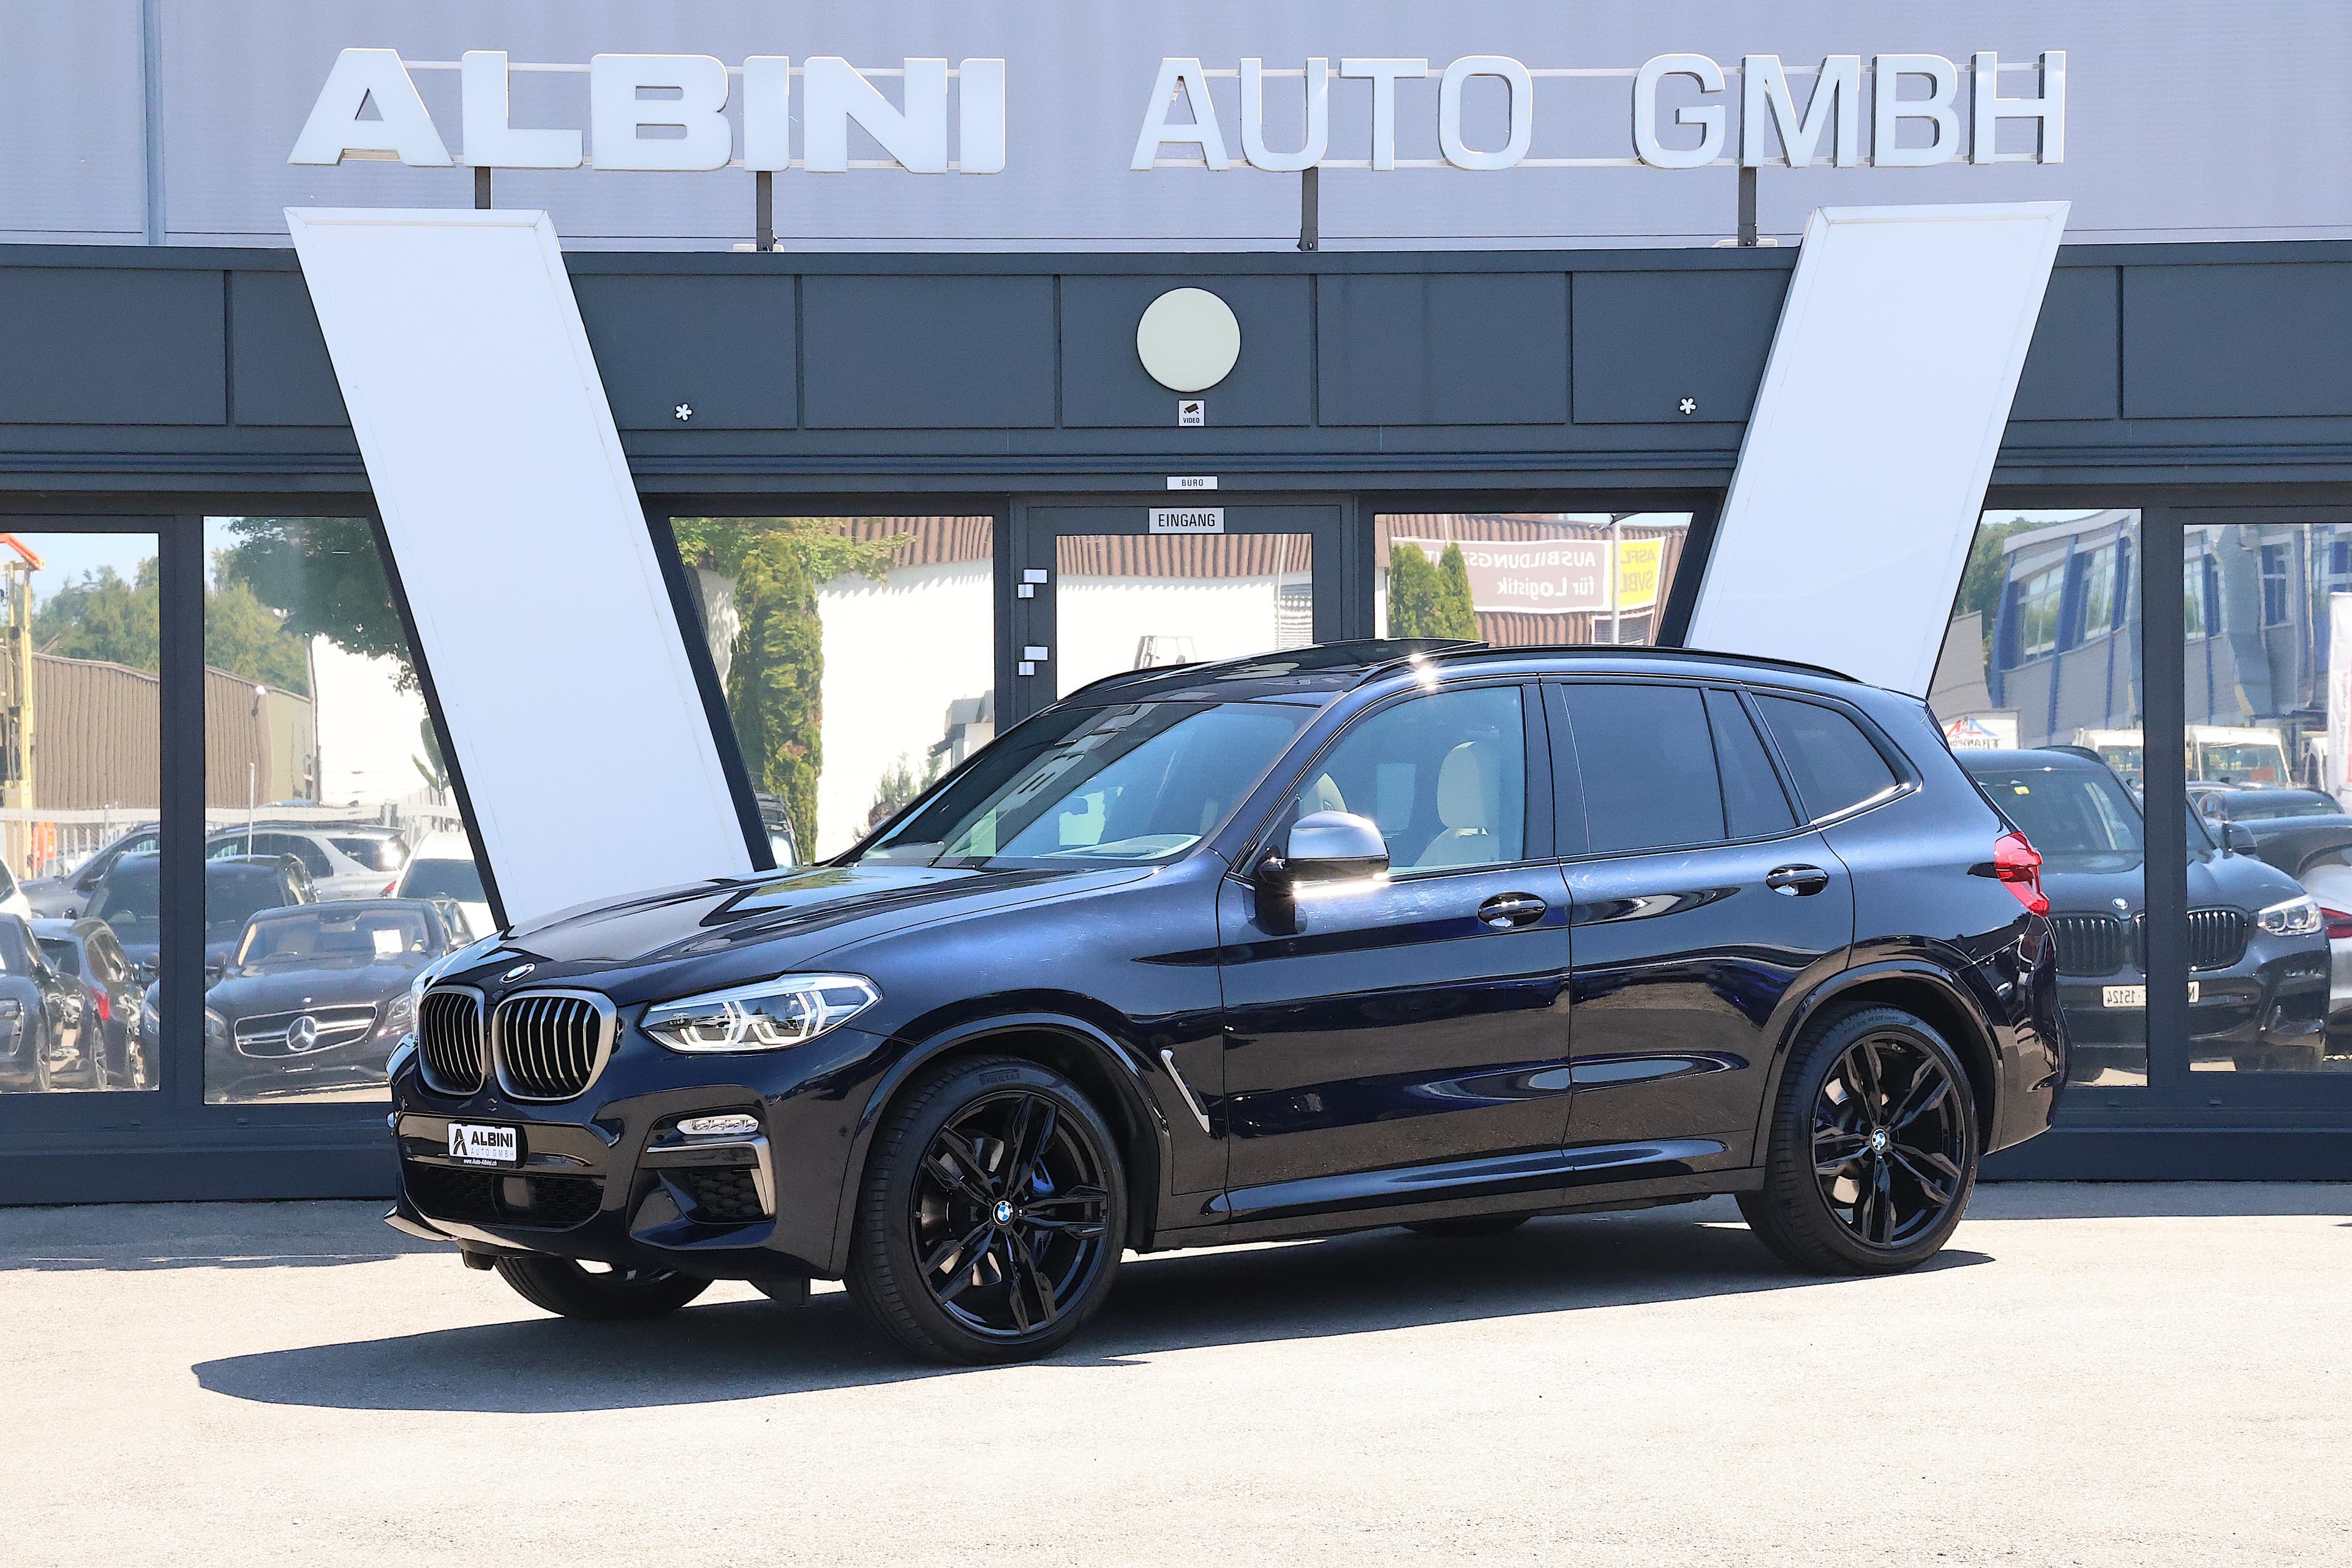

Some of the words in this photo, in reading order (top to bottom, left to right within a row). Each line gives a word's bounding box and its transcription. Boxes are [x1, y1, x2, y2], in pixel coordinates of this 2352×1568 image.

[287, 47, 1006, 175] ALBINI
[1130, 54, 1533, 172] AUTO
[1630, 49, 2067, 170] GMBH
[1182, 477, 1204, 486] BÜRO
[1158, 513, 1216, 527] EINGANG
[470, 1131, 513, 1148] ALBINI
[470, 1148, 489, 1156] AUTO
[493, 1149, 514, 1158] GMBH
